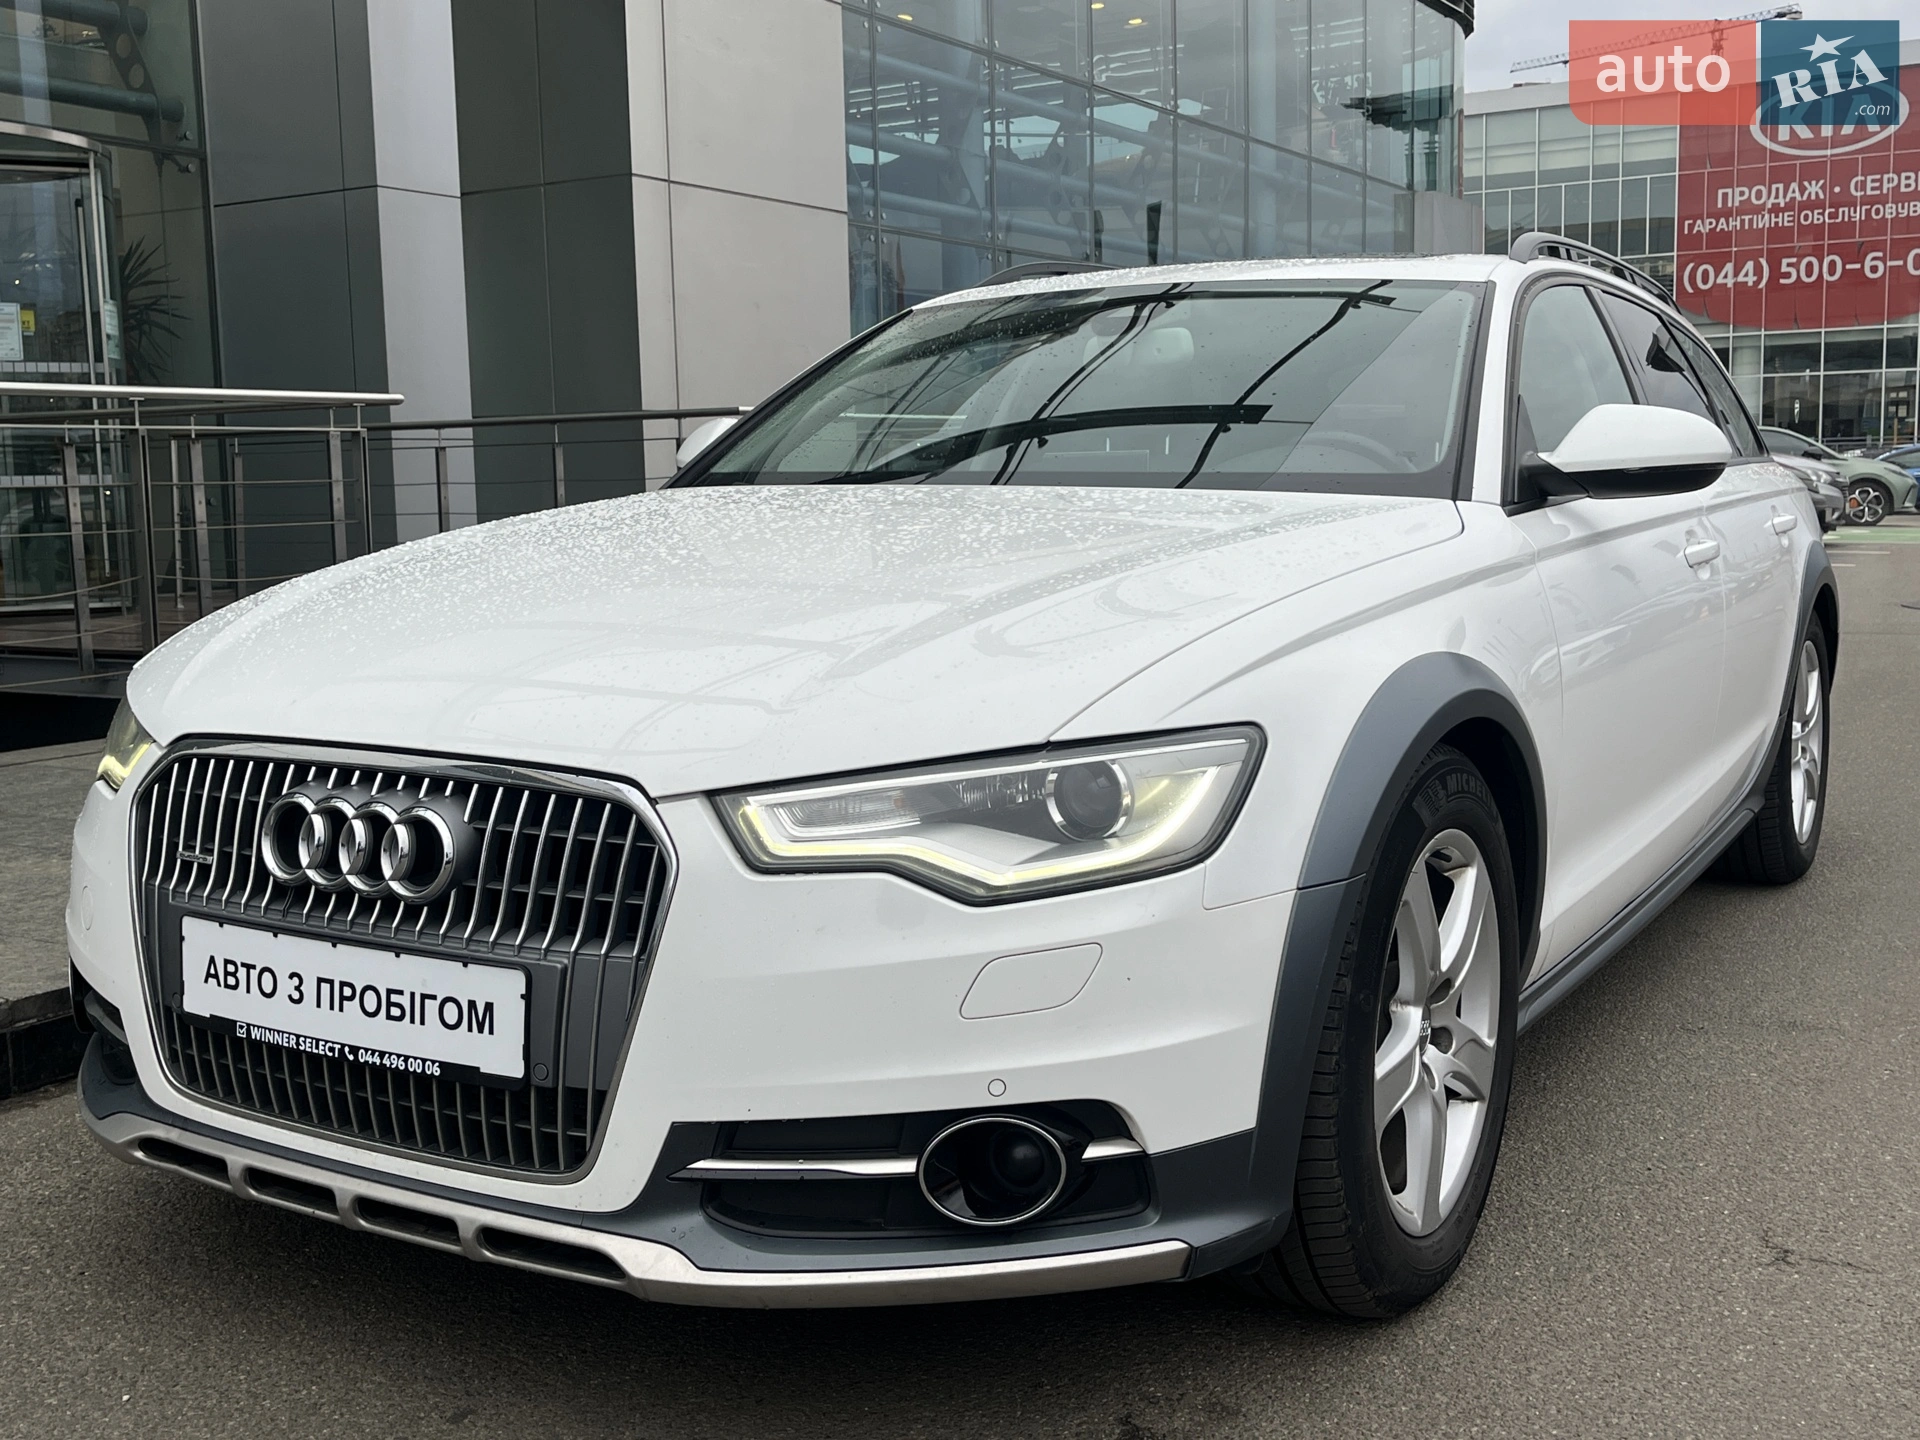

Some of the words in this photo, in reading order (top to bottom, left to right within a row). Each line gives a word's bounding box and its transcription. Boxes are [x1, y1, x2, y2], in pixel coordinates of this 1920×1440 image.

[1717, 179, 1825, 208] ПРОДАЖ
[1850, 171, 1920, 197] СЕРВ
[1683, 210, 1794, 234] ГАРАНТІЙНЕ
[1683, 257, 1770, 293] (044)
[203, 954, 278, 999] АВТО
[287, 971, 305, 1005] З
[315, 976, 495, 1036] ПРОБІГОМ
[250, 1026, 297, 1050] WINNER
[298, 1035, 341, 1058] SELECT
[358, 1048, 381, 1066] 044
[382, 1053, 405, 1071] 496
[407, 1057, 423, 1073] 00
[424, 1060, 441, 1076] 06
